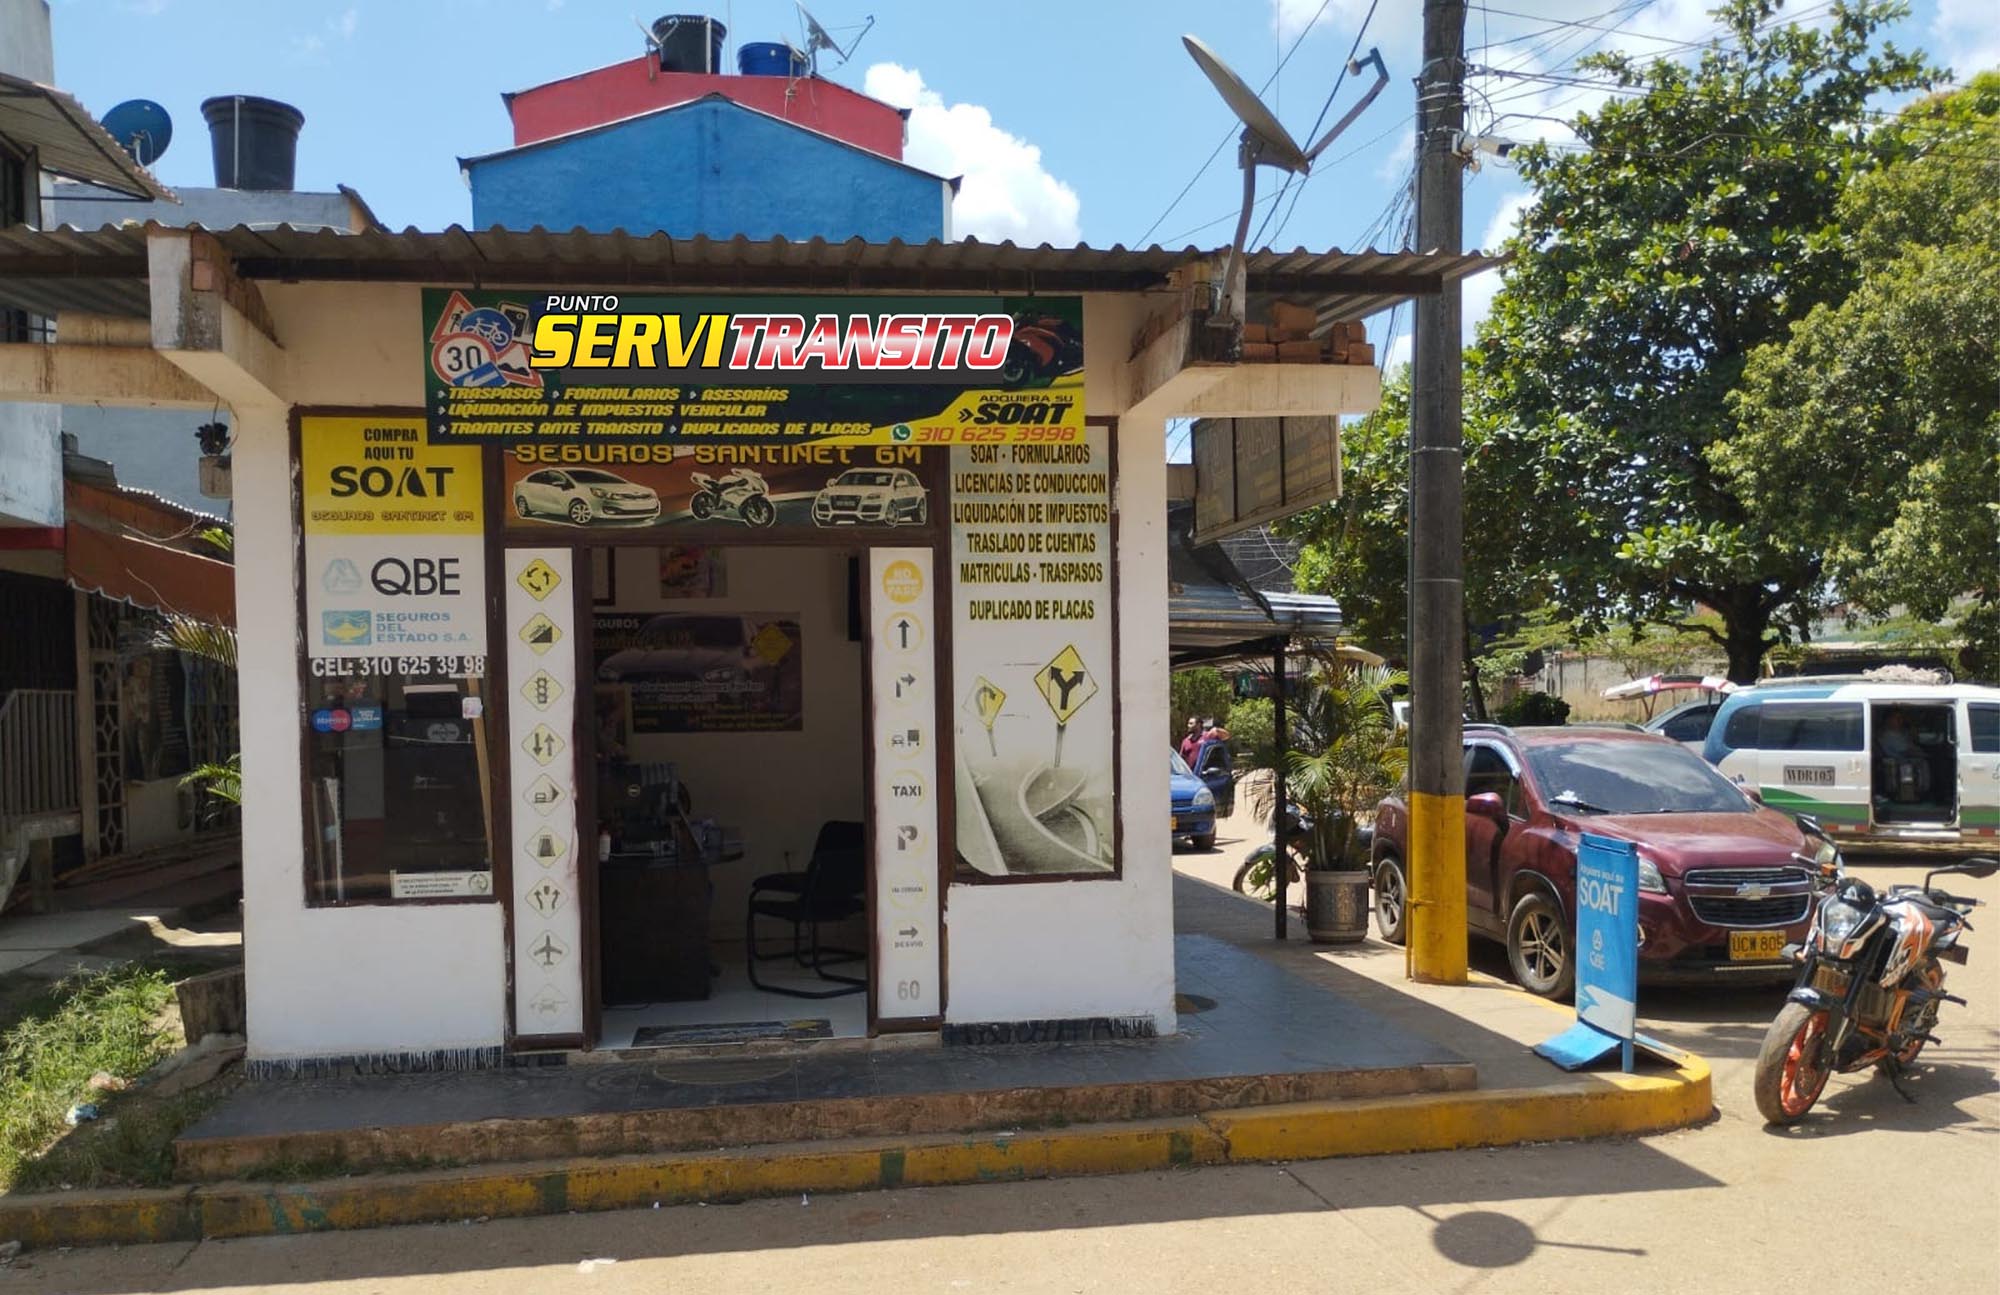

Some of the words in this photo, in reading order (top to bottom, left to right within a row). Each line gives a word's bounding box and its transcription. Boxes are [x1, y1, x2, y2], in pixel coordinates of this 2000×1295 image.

[546, 295, 619, 312] PUNTO
[530, 313, 1015, 370] SERVITRANSITO
[446, 345, 482, 372] 30
[449, 387, 544, 400] TRASPASOS
[564, 387, 681, 401] FORMULARIOS
[701, 386, 790, 402] ASESORÍAS
[979, 395, 1051, 403] ADQUIERA
[1055, 395, 1073, 403] SU
[448, 401, 549, 418] LIQUIDACIÓN
[552, 403, 577, 416] DE
[579, 403, 675, 417] IMPUESTOS
[680, 404, 768, 417] VEHICULAR
[973, 403, 1074, 426] SOAT
[363, 428, 419, 443] COMPRA
[450, 422, 535, 435] TRAMITES
[538, 422, 582, 434] ANTE
[587, 422, 664, 435] TRANSITO
[680, 422, 780, 435] DUPLICADOS
[783, 422, 806, 435] DE
[809, 422, 872, 435] PLACAS
[915, 427, 954, 443] 310
[960, 427, 1007, 442] 625
[1013, 427, 1077, 442] 3998
[364, 446, 395, 461] AQUI
[399, 446, 414, 460] TU
[515, 444, 673, 465] SEGUROS
[694, 444, 856, 465] SANTINET
[970, 444, 1000, 463] SOAT
[1012, 444, 1091, 464] FORMULARIOS
[330, 465, 454, 498] SOAT
[955, 473, 1013, 493] LICENCIAS
[1016, 473, 1031, 493] DE
[1034, 473, 1106, 493] CONDUCCION
[953, 498, 1025, 523] LIQUIDACIÓN
[1028, 503, 1042, 523] DE
[1045, 503, 1108, 523] IMPUESTOS
[967, 533, 1025, 553] TRASLADO
[1028, 533, 1042, 553] DE
[1045, 533, 1096, 553] CUENTAS
[370, 557, 461, 596] QBE
[960, 562, 1031, 583] MATRICULAS
[1039, 562, 1103, 582] TRASPASOS
[376, 612, 450, 622] SEGUROS
[969, 600, 1032, 620] DUPLICADO
[1035, 600, 1049, 620] DE
[1052, 600, 1094, 620] PLACAS
[376, 623, 405, 633] DEL
[376, 633, 438, 643] ESTADO
[311, 657, 354, 677] CEL:
[360, 656, 392, 677] 310
[397, 656, 431, 675] 625
[436, 656, 459, 674] 39
[463, 655, 485, 674] 98
[1786, 768, 1832, 784] WDR105
[892, 785, 921, 797] TAXI
[1579, 876, 1624, 915] SOAT
[1760, 932, 1785, 952] 805
[897, 979, 920, 1001] 60
